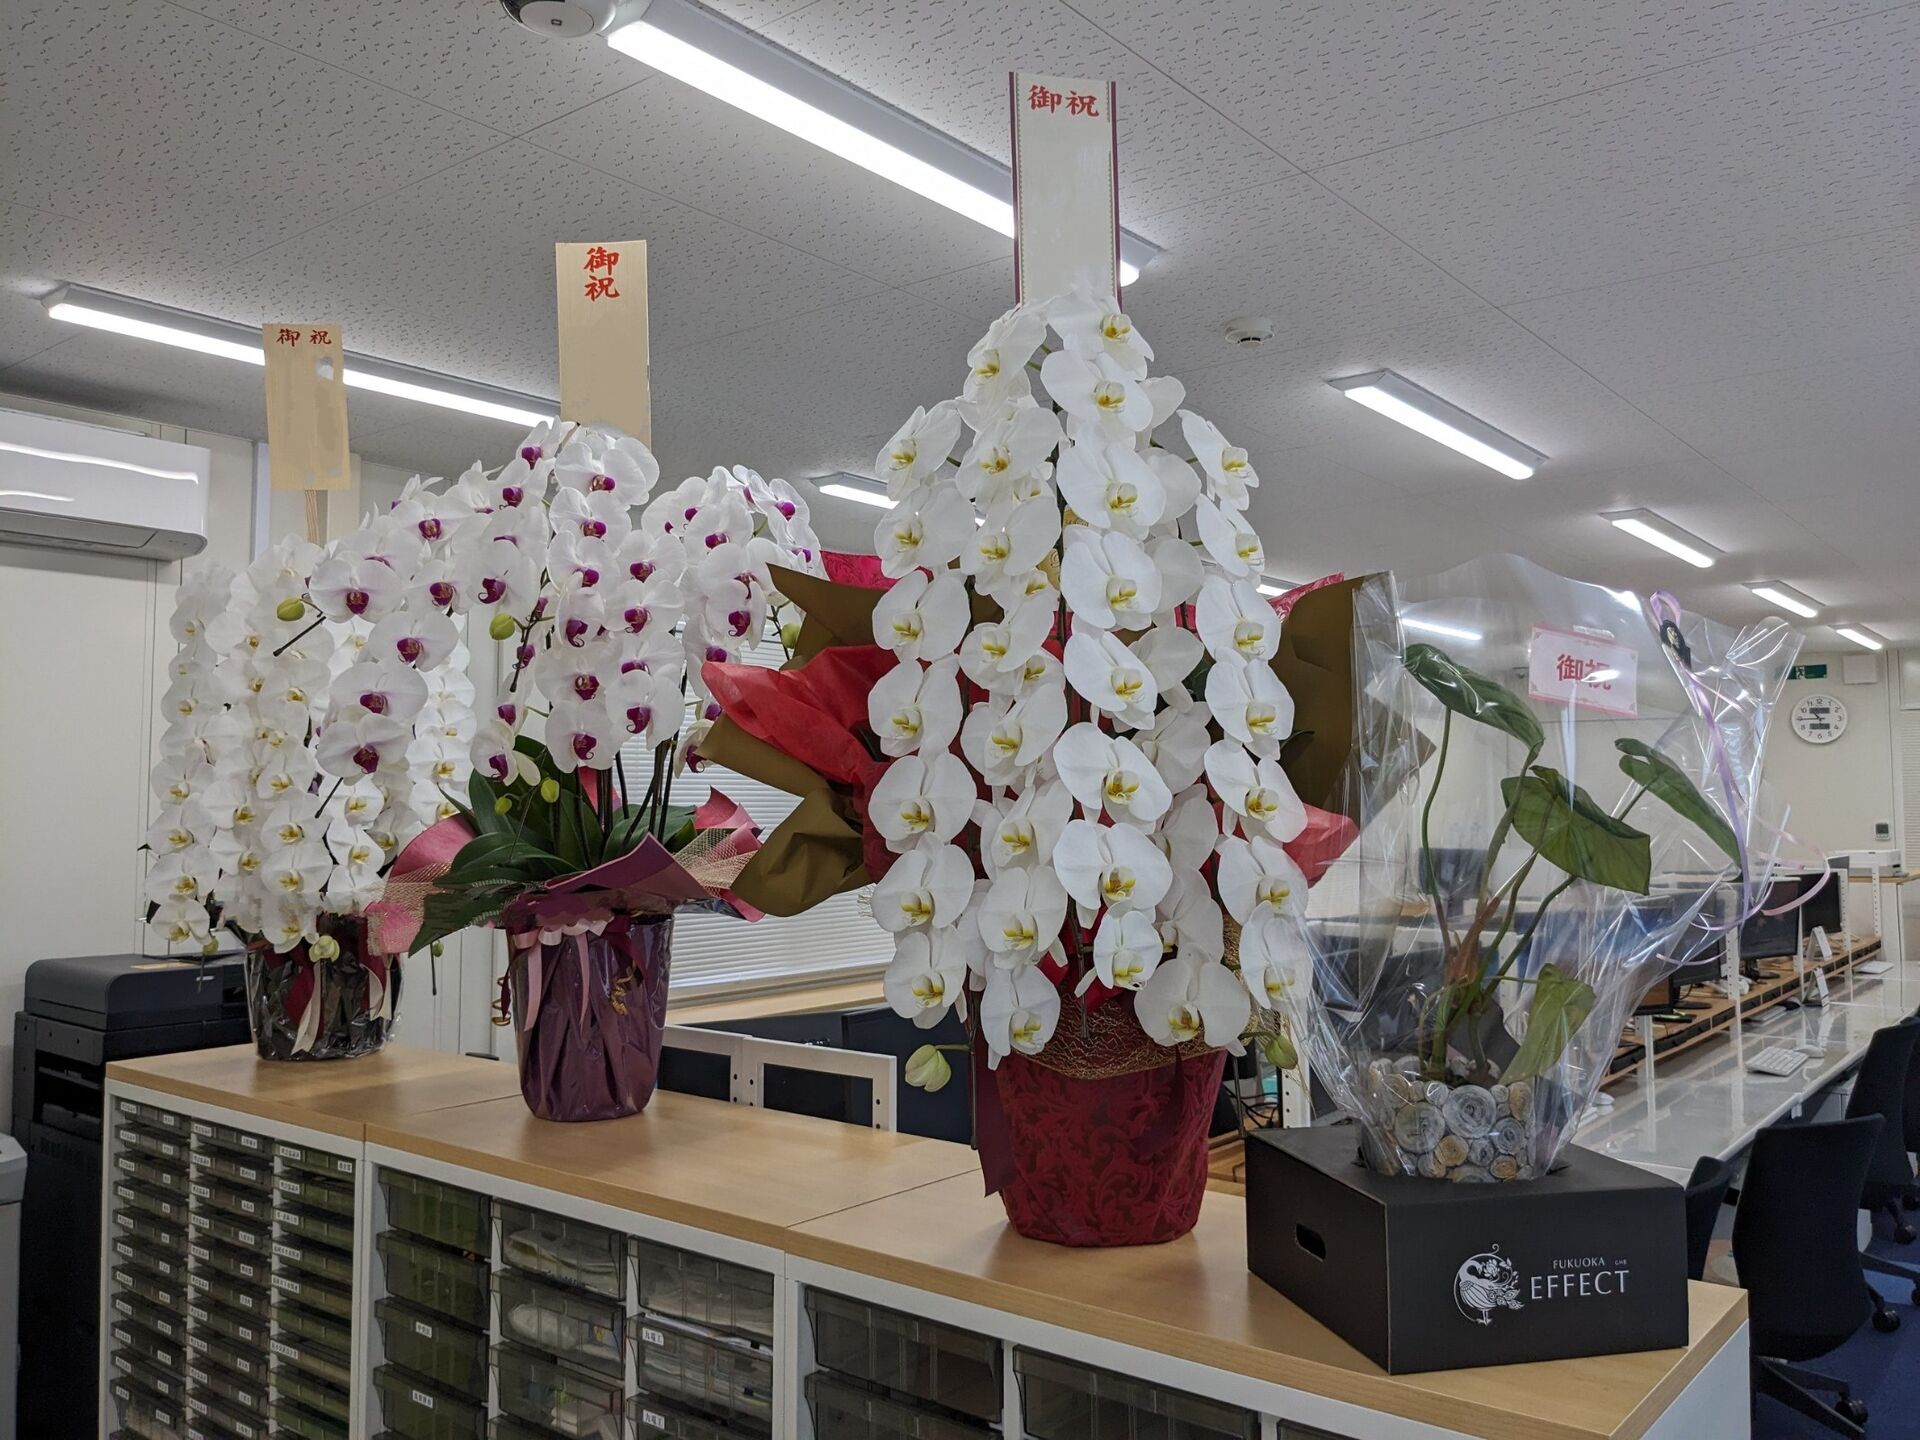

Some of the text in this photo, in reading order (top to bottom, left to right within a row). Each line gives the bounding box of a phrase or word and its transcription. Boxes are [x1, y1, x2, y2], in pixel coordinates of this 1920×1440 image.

[1028, 84, 1100, 117] 御祝
[583, 246, 621, 302] 御祝
[275, 328, 333, 347] 御祝
[1553, 1257, 1606, 1270] FUKUOKA
[1530, 1270, 1630, 1300] EFFECT
